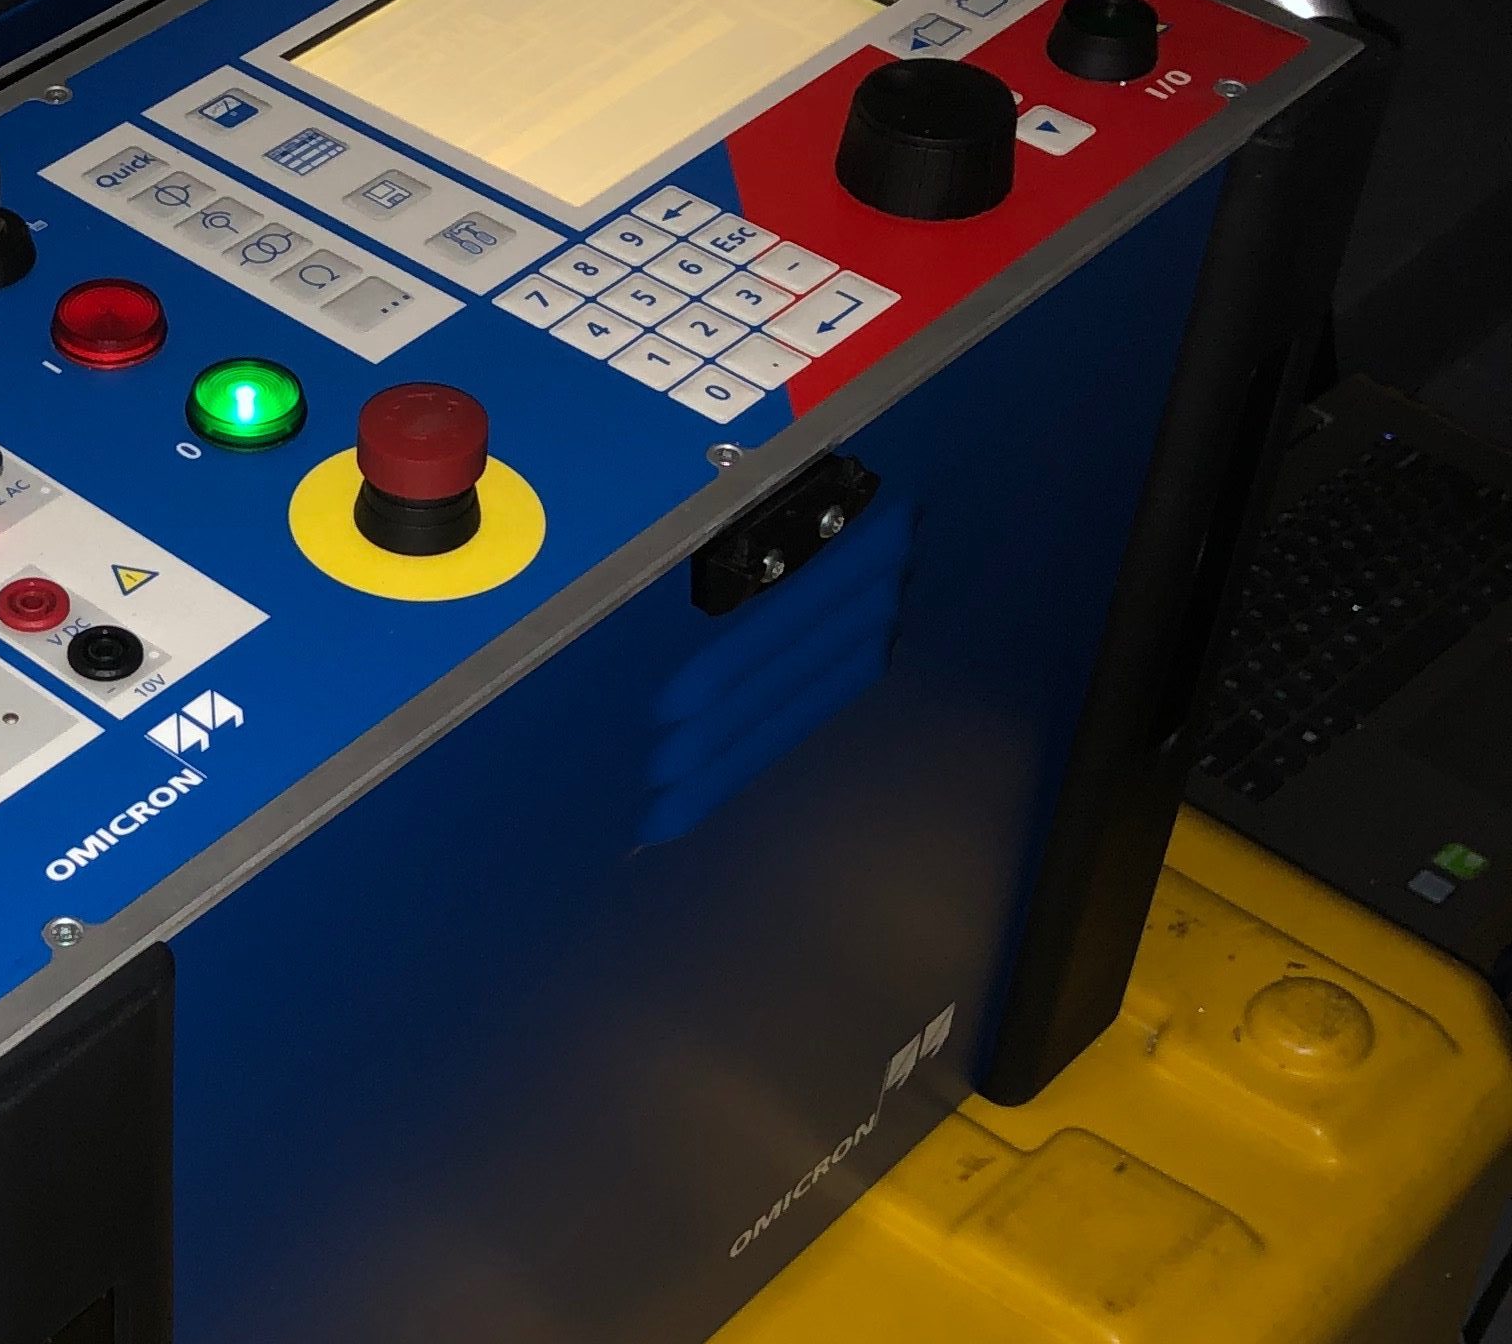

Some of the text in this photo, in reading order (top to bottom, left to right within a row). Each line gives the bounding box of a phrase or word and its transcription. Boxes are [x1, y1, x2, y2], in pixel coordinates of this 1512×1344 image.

[1144, 70, 1192, 100] I/O
[96, 152, 158, 188] Quick
[524, 231, 644, 308] 7 8 9
[586, 322, 610, 338] 4
[630, 290, 657, 307] 5
[678, 259, 703, 275] 6
[646, 288, 762, 366] 1 2 3
[704, 384, 732, 401] 0
[4, 479, 32, 500] AC
[46, 632, 63, 648] V
[134, 674, 166, 698] 10V
[45, 768, 204, 882] OMICRON
[728, 1112, 877, 1260] OMICRON
